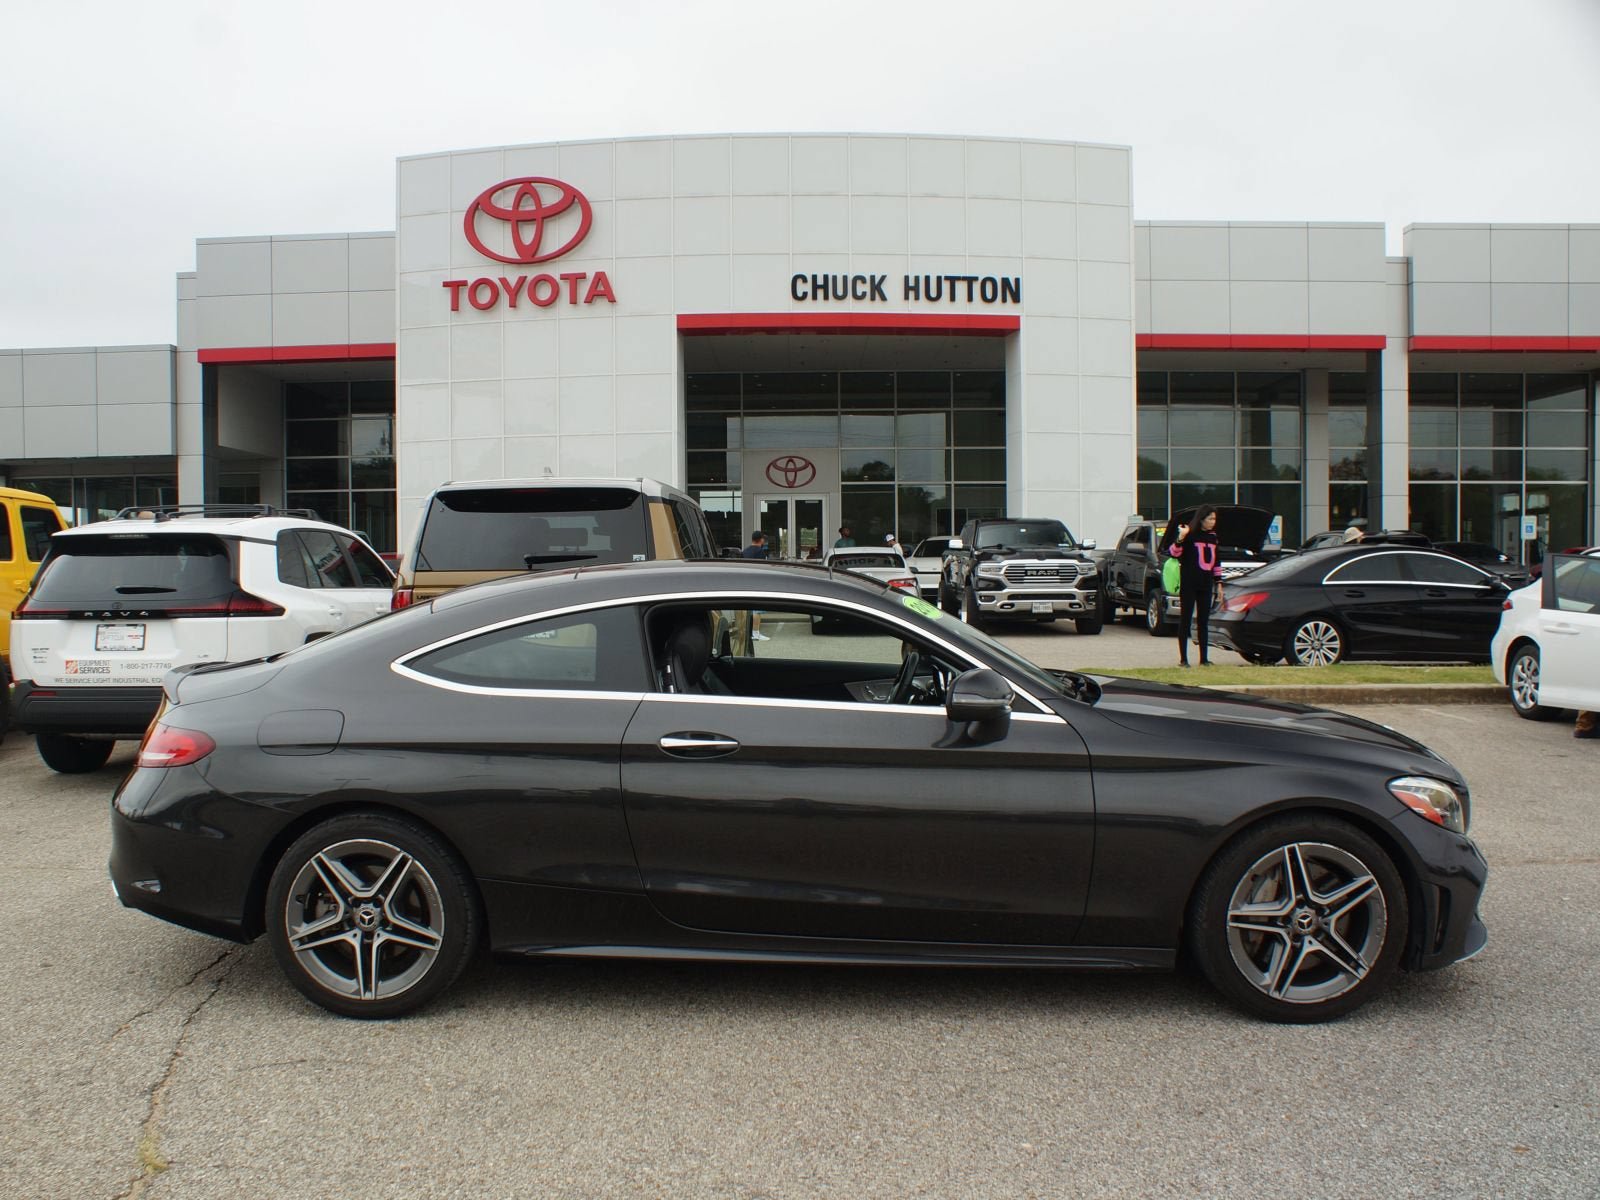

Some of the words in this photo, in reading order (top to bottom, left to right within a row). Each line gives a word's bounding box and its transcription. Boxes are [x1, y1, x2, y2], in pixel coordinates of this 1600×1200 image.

[442, 271, 617, 312] TOYOTA
[791, 273, 888, 302] CHUCK
[904, 275, 1021, 303] HUTTON
[1194, 542, 1217, 571] U
